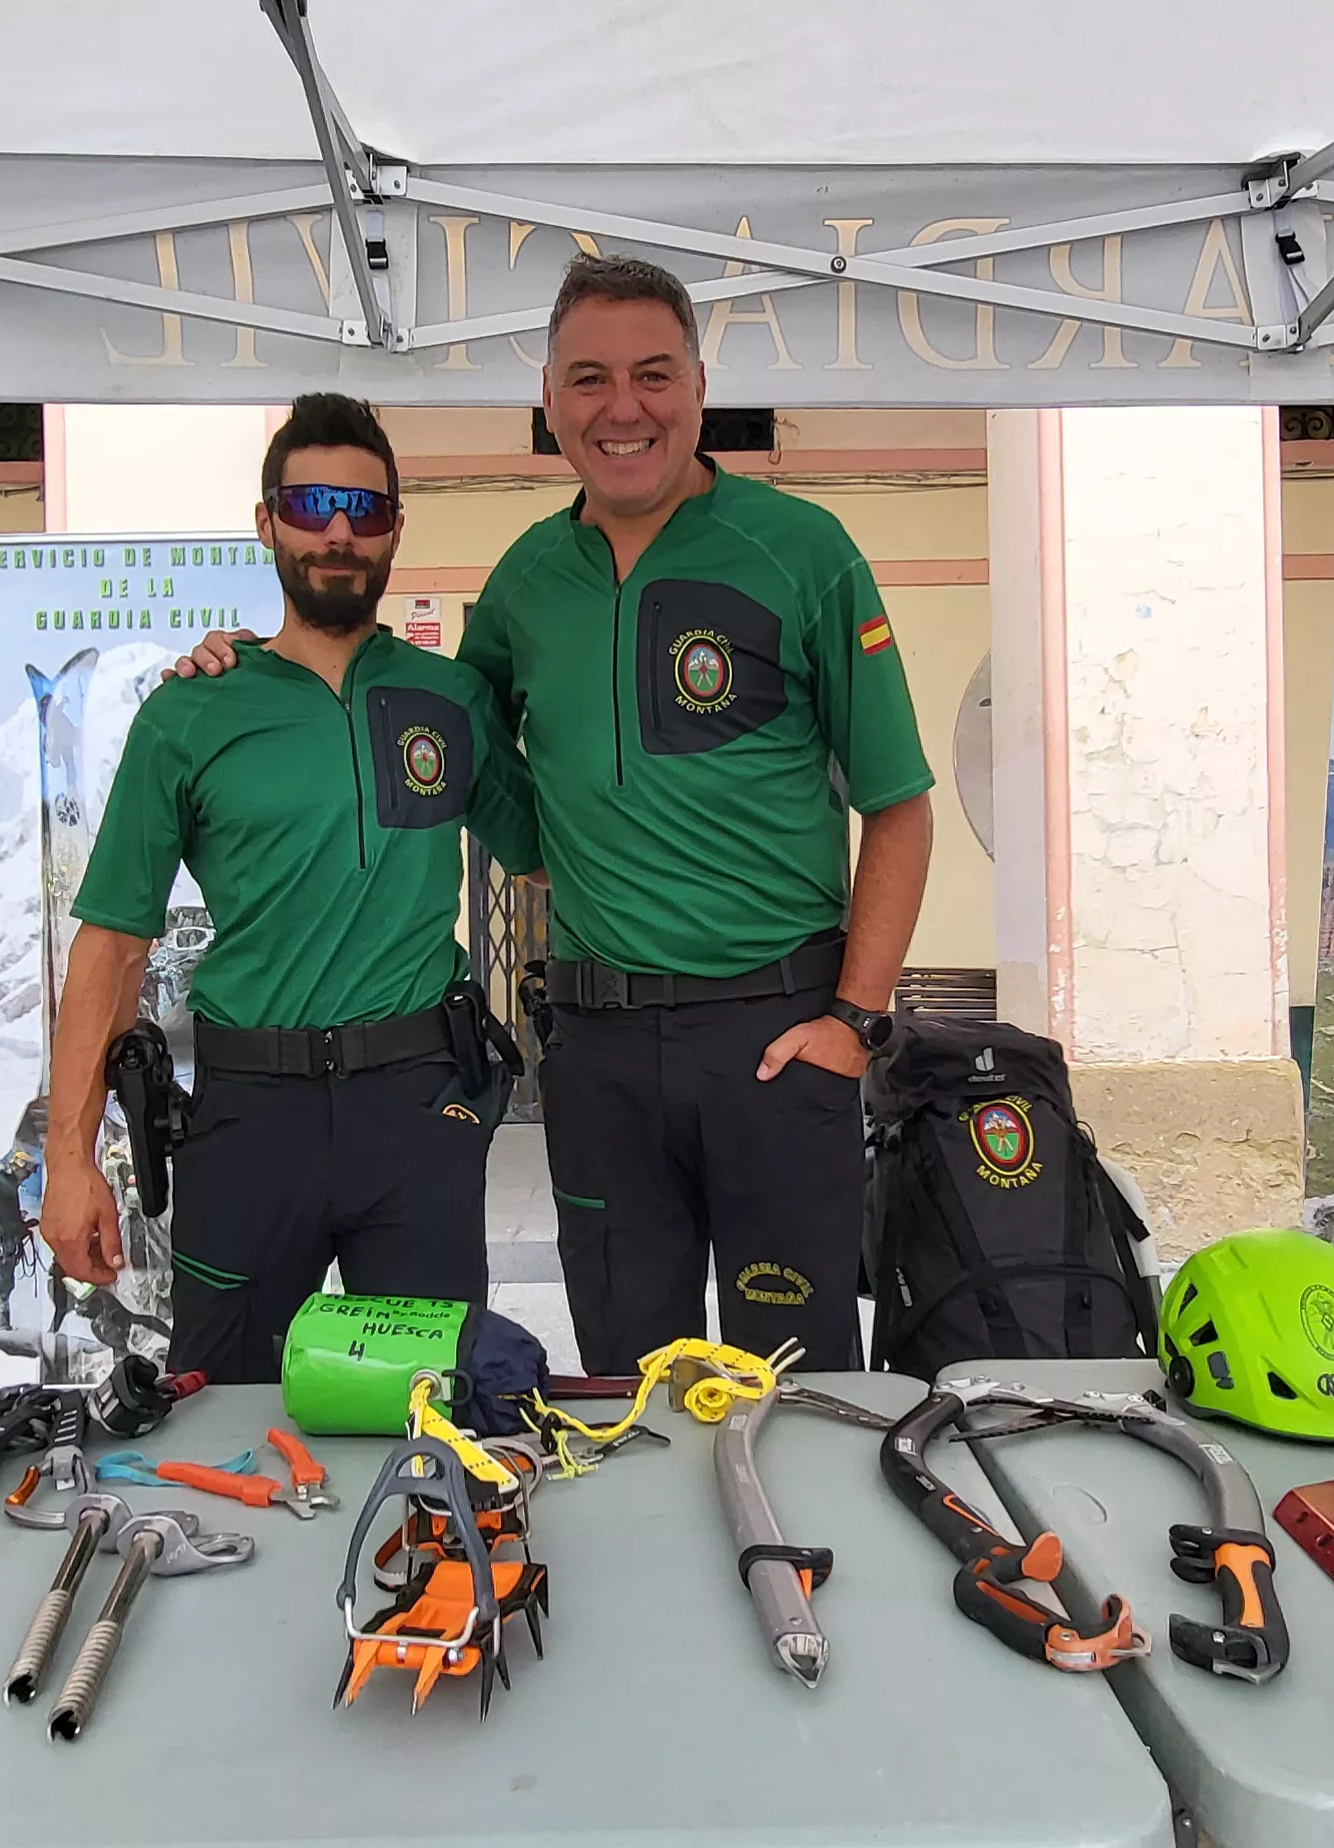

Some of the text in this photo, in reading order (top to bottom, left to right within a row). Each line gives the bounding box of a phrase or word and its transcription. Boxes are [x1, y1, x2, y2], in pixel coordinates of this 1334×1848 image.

[124, 547, 152, 568] DE
[99, 577, 174, 598] DE LA
[35, 607, 241, 630] GUARDIA CIVIL
[668, 629, 715, 655] GUARDIA
[362, 1322, 444, 1340] HUESCA
[348, 1339, 365, 1362] 4
